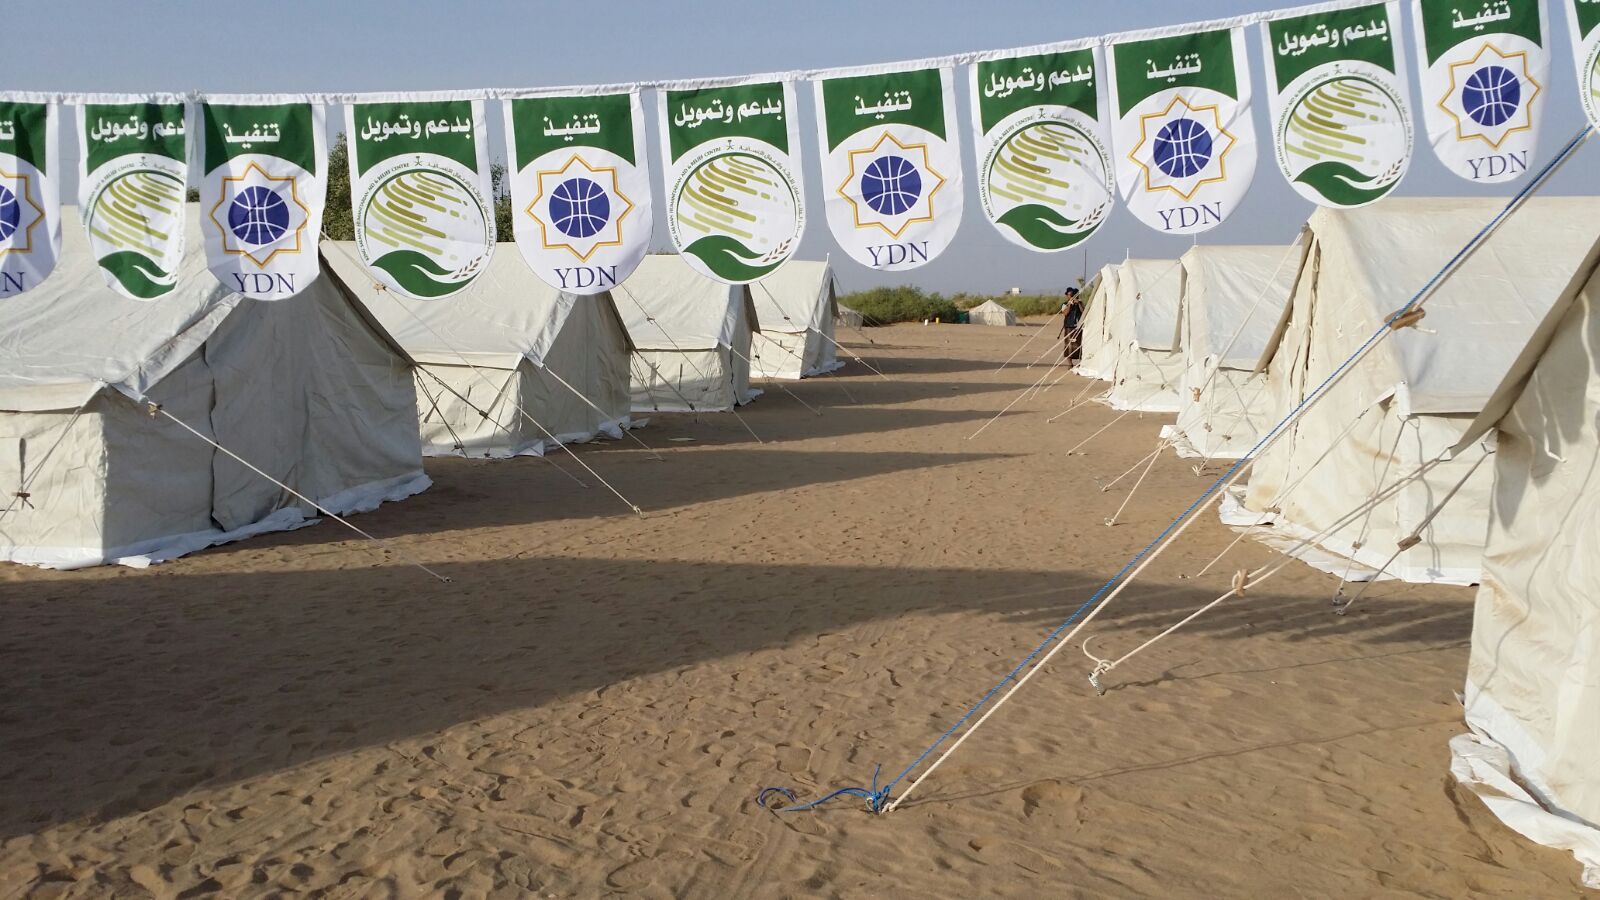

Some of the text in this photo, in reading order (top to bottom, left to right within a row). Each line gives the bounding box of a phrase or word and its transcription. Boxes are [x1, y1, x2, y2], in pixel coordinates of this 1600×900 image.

[1452, 1, 1511, 31] تنفيذ
[1278, 18, 1388, 57] بدعم وتمويل
[984, 64, 1093, 99] بدعم وتمويل
[1146, 54, 1202, 83] تنفيذ
[674, 97, 783, 129] بدعم وتمويل
[854, 90, 913, 120] تنفيذ
[90, 115, 185, 143] دعم وتمويل
[223, 122, 281, 149] تنفيذ
[360, 114, 472, 142] بدعم وتمويل
[543, 113, 601, 142] تنفيذ
[1466, 150, 1528, 179] YDN
[1159, 202, 1222, 231] YDN
[866, 241, 929, 267] YDN
[232, 273, 296, 294] YDN
[555, 266, 619, 289] YDN
